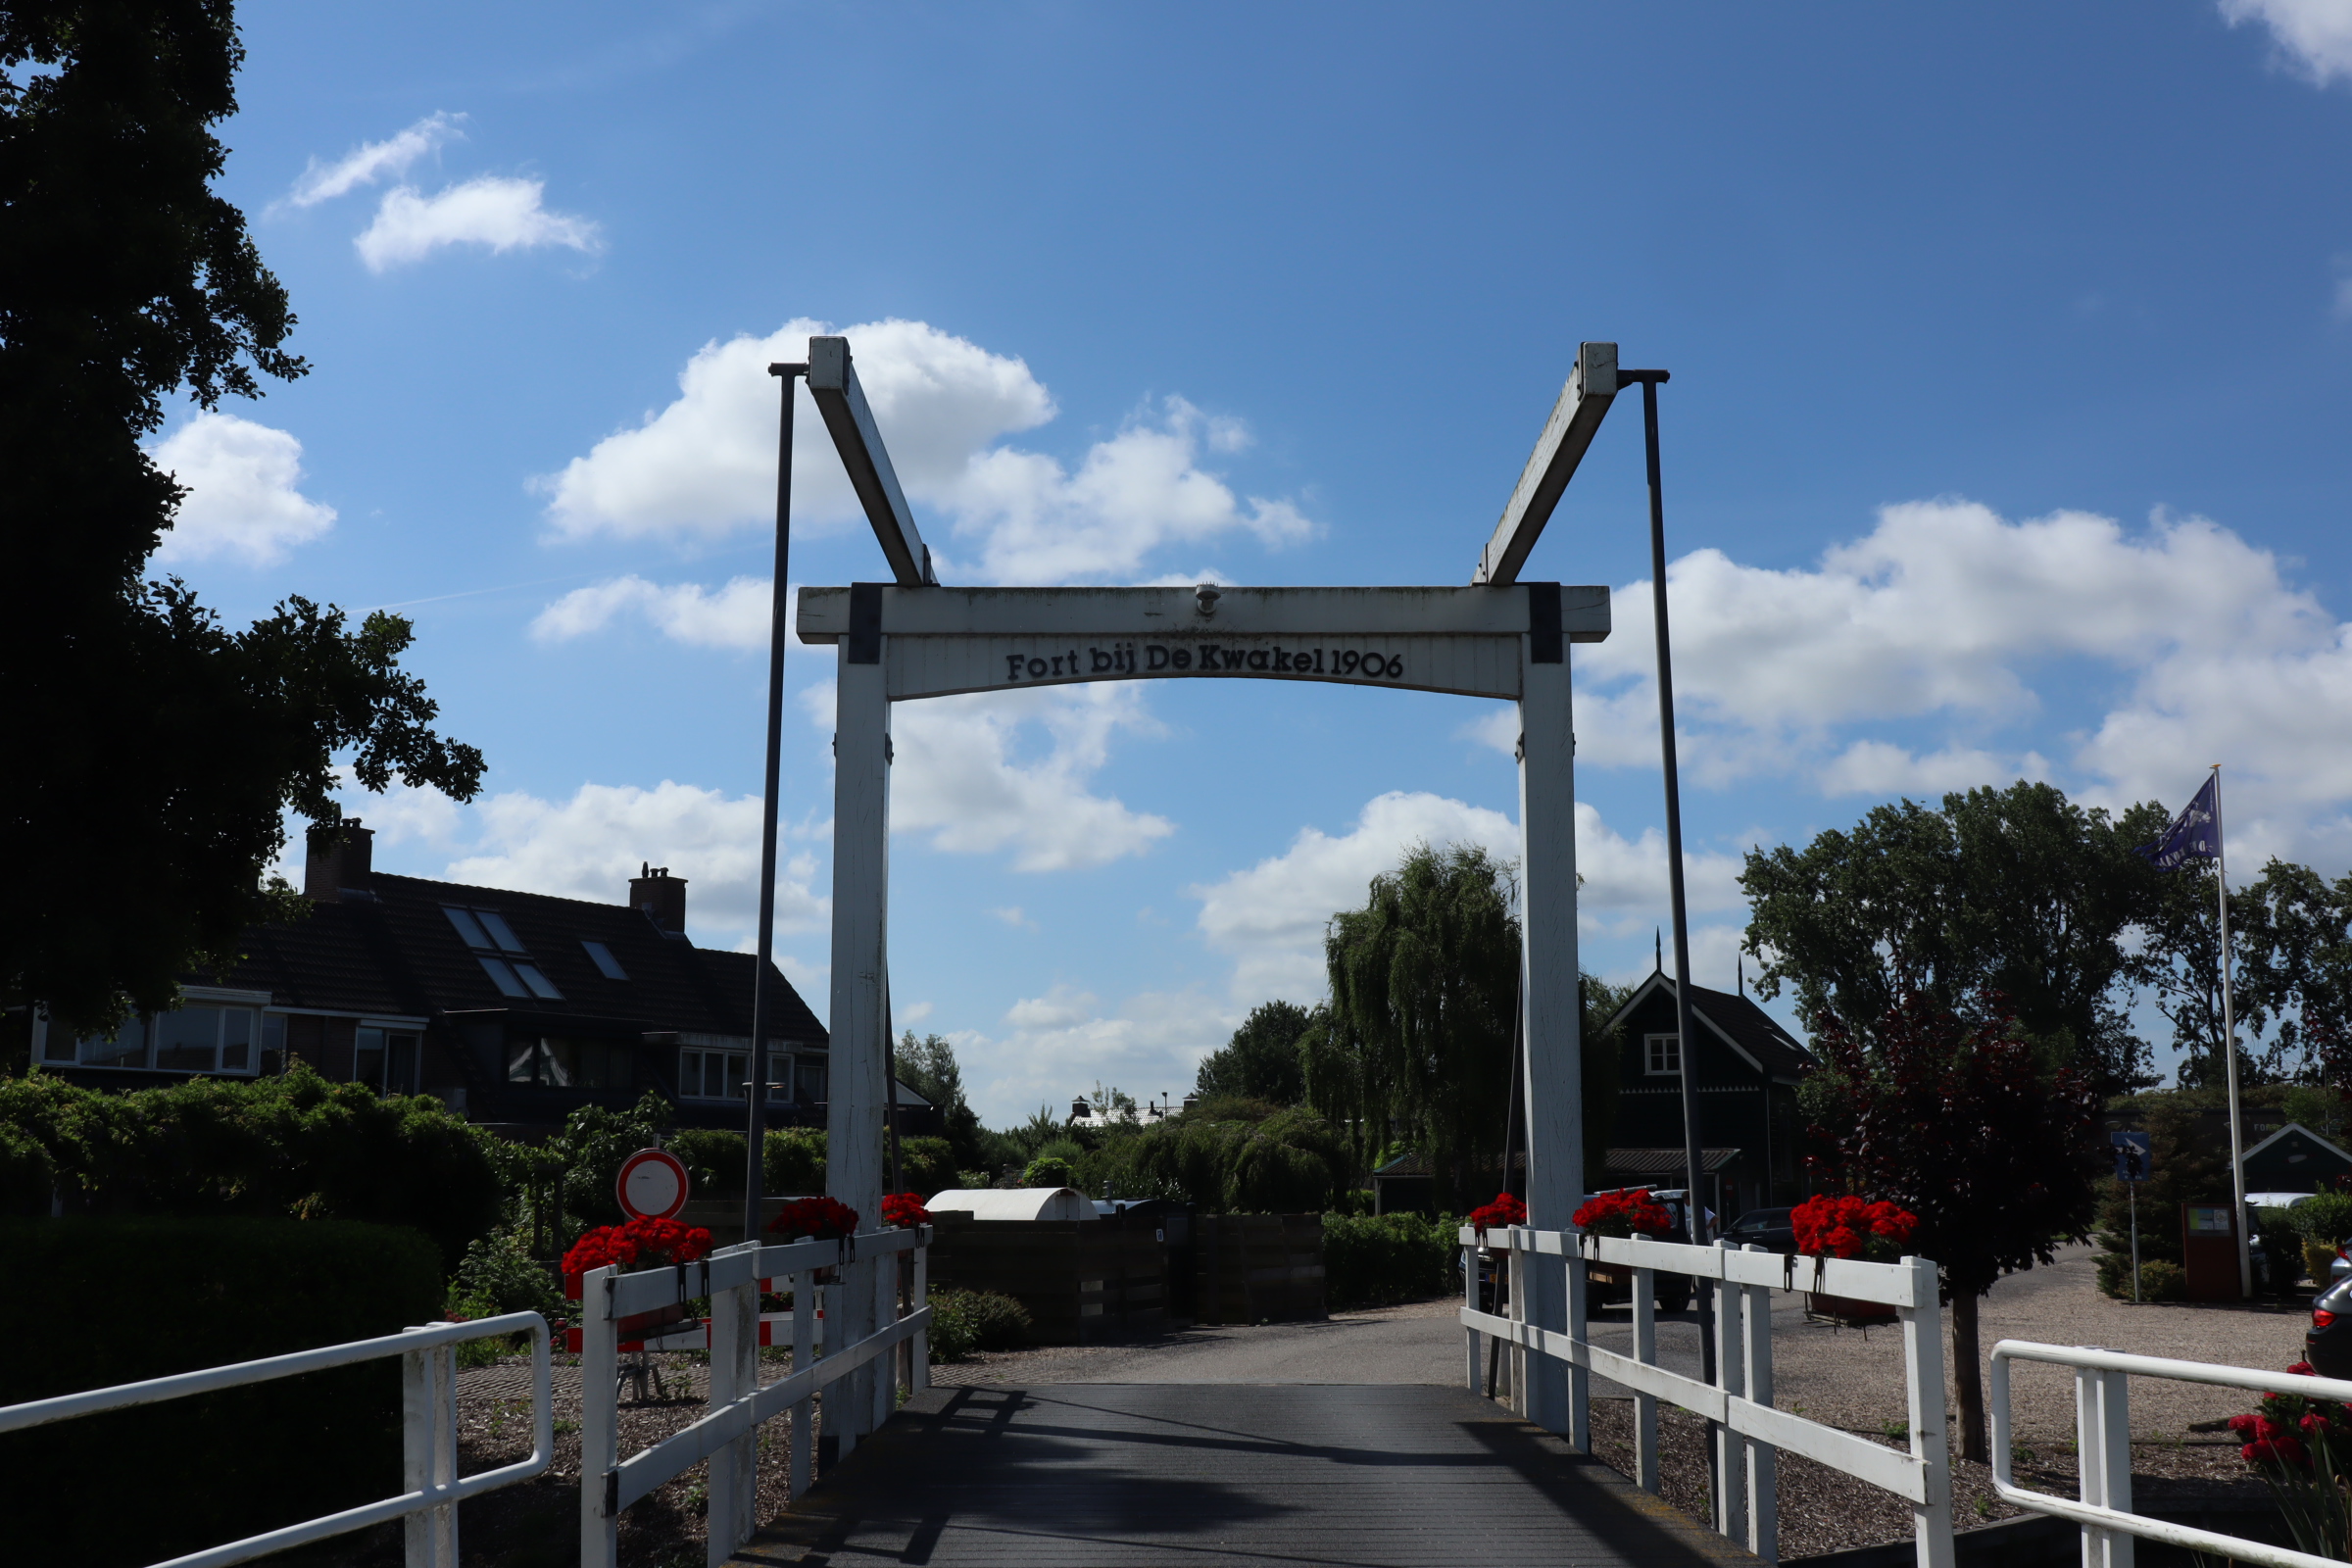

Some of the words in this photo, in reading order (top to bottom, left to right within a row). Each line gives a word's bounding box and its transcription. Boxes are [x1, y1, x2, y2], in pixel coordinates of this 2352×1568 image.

[1005, 649, 1079, 680] Fort
[1089, 642, 1135, 674] bij
[1147, 644, 1193, 669] De
[1199, 644, 1325, 673] Kwakel
[1331, 649, 1403, 678] 1906
